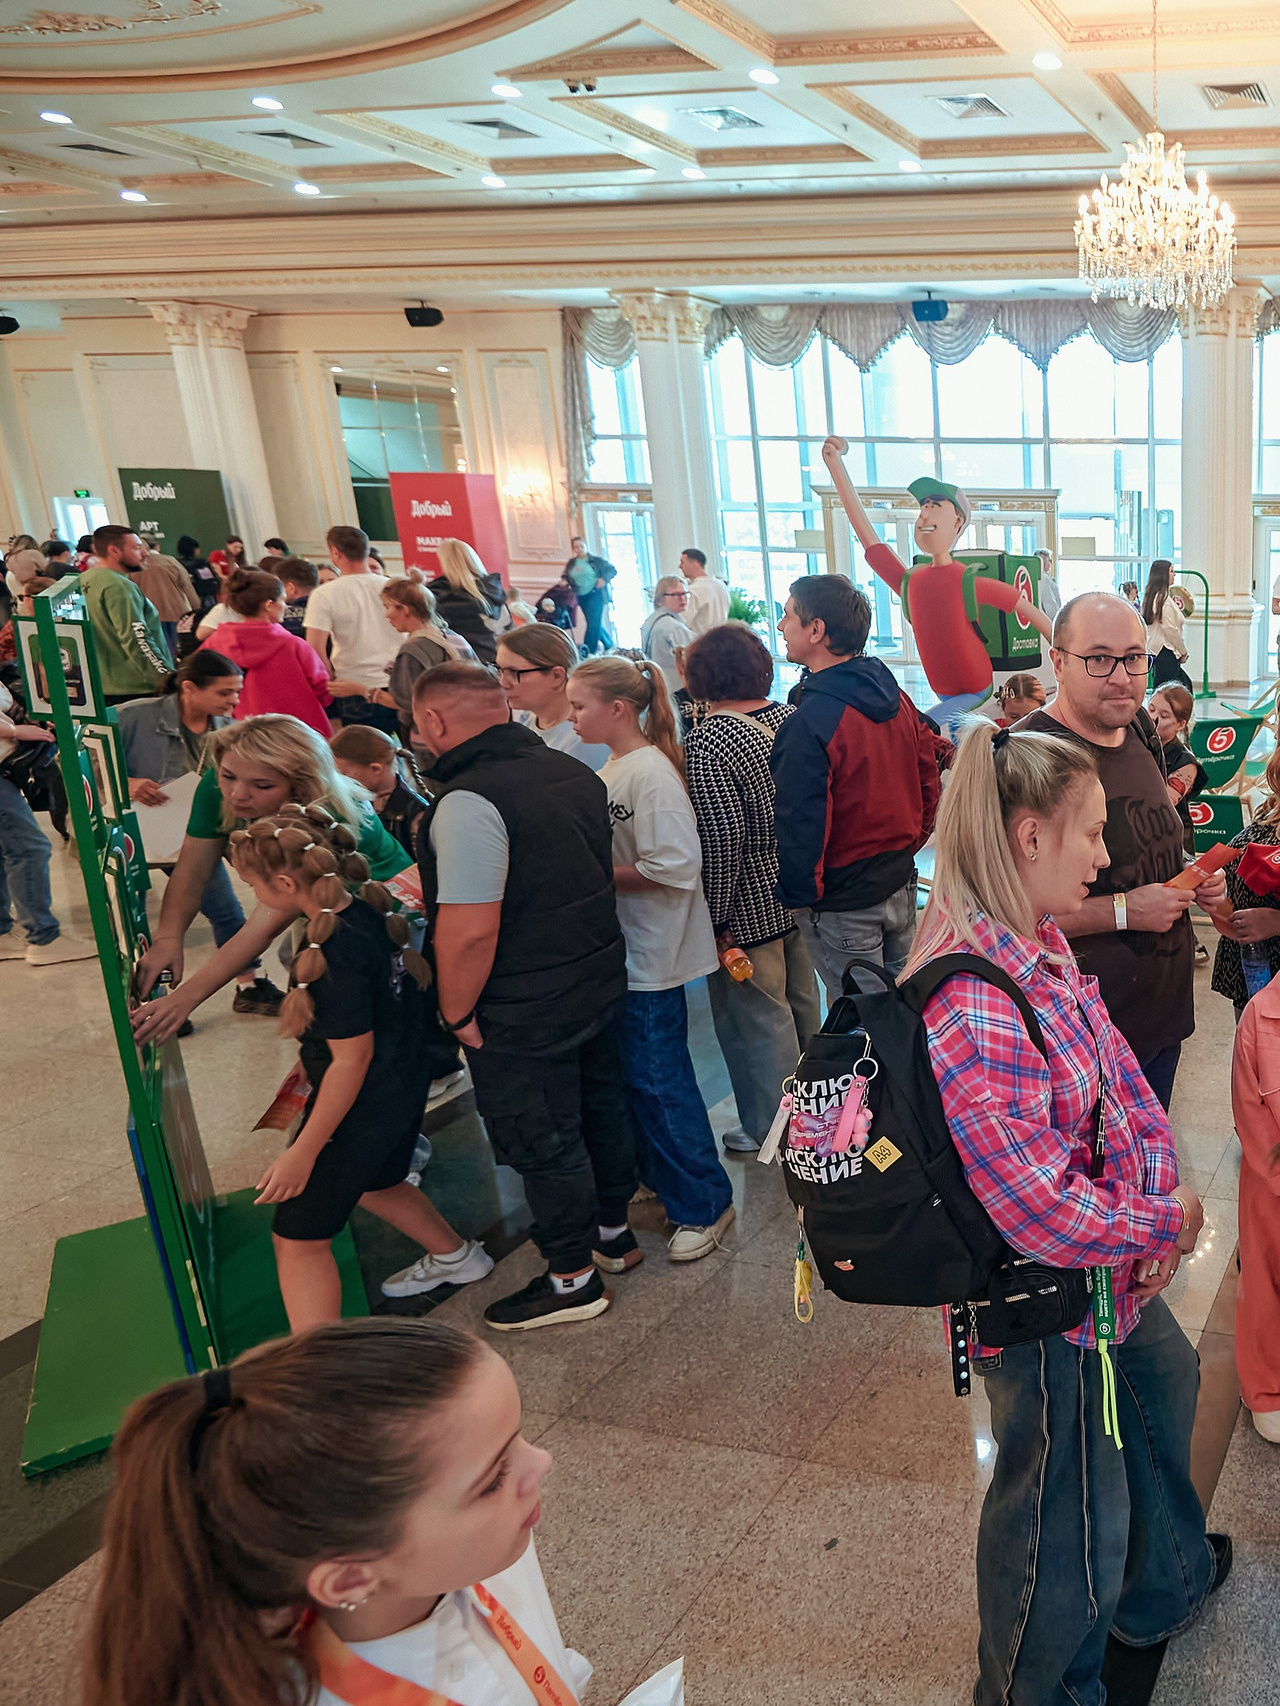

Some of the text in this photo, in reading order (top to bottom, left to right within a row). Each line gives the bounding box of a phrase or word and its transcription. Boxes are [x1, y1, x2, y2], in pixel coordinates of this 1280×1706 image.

[131, 481, 176, 500] Добрый
[410, 499, 453, 518] Добрый
[140, 521, 159, 531] АРТ
[1012, 637, 1038, 652] Доставка
[792, 1073, 855, 1098] СКЛЮ
[788, 1157, 863, 1185] ЧЕНИЕ
